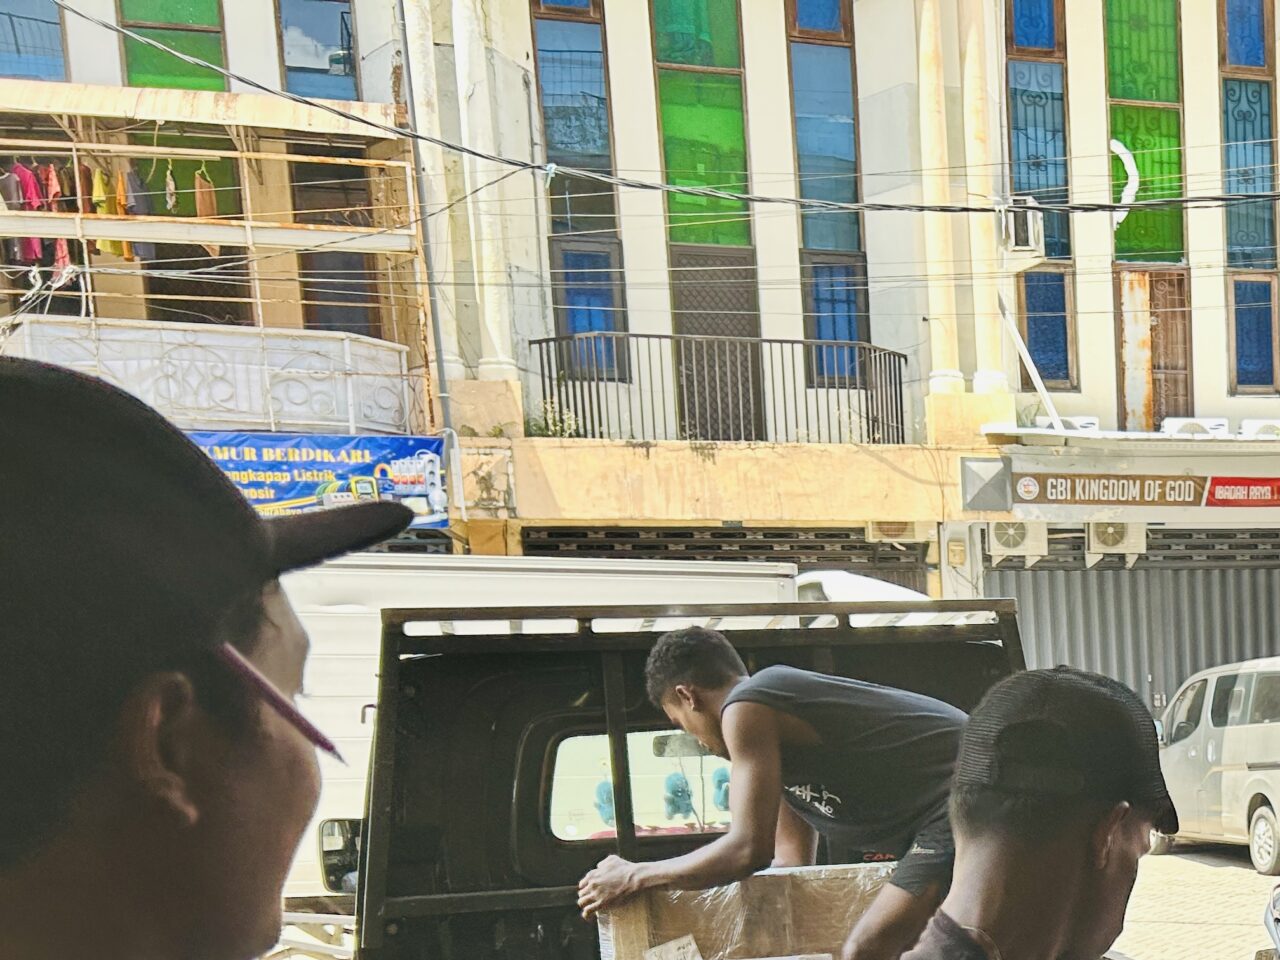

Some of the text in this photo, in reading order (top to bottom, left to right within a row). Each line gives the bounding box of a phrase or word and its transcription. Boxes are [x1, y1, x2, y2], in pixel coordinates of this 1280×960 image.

[262, 447, 371, 463] BERDIKARI
[293, 468, 336, 481] Listrik
[1046, 478, 1071, 500] GBI
[1075, 479, 1140, 501] KINGDOM
[1144, 480, 1162, 502] OF
[1165, 480, 1194, 502] GOD
[1215, 485, 1248, 499] IBADAH
[1249, 485, 1271, 499] RAYA
